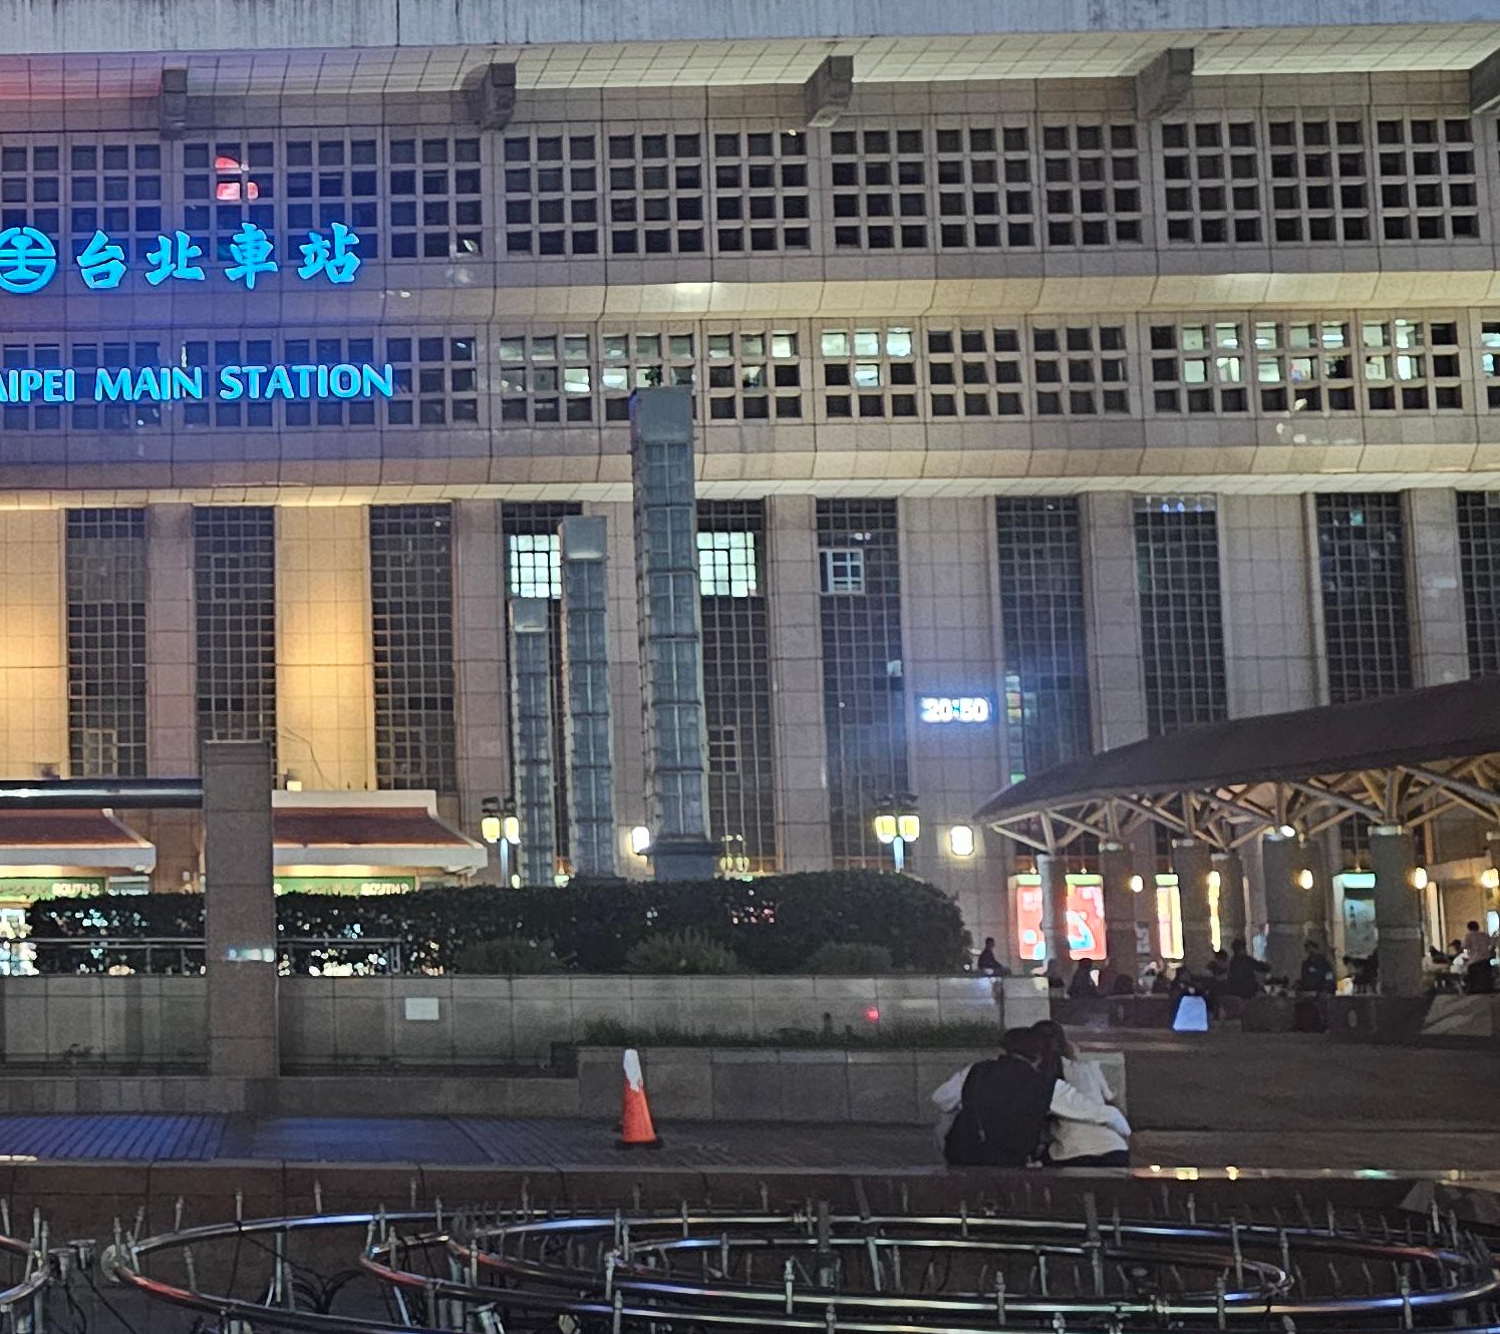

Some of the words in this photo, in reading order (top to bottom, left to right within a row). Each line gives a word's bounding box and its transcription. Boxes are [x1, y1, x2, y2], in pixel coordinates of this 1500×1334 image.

[76, 222, 361, 289] 台北車站
[94, 366, 202, 401] MAIN
[219, 363, 394, 400] STATION
[921, 697, 989, 723] 20:50
